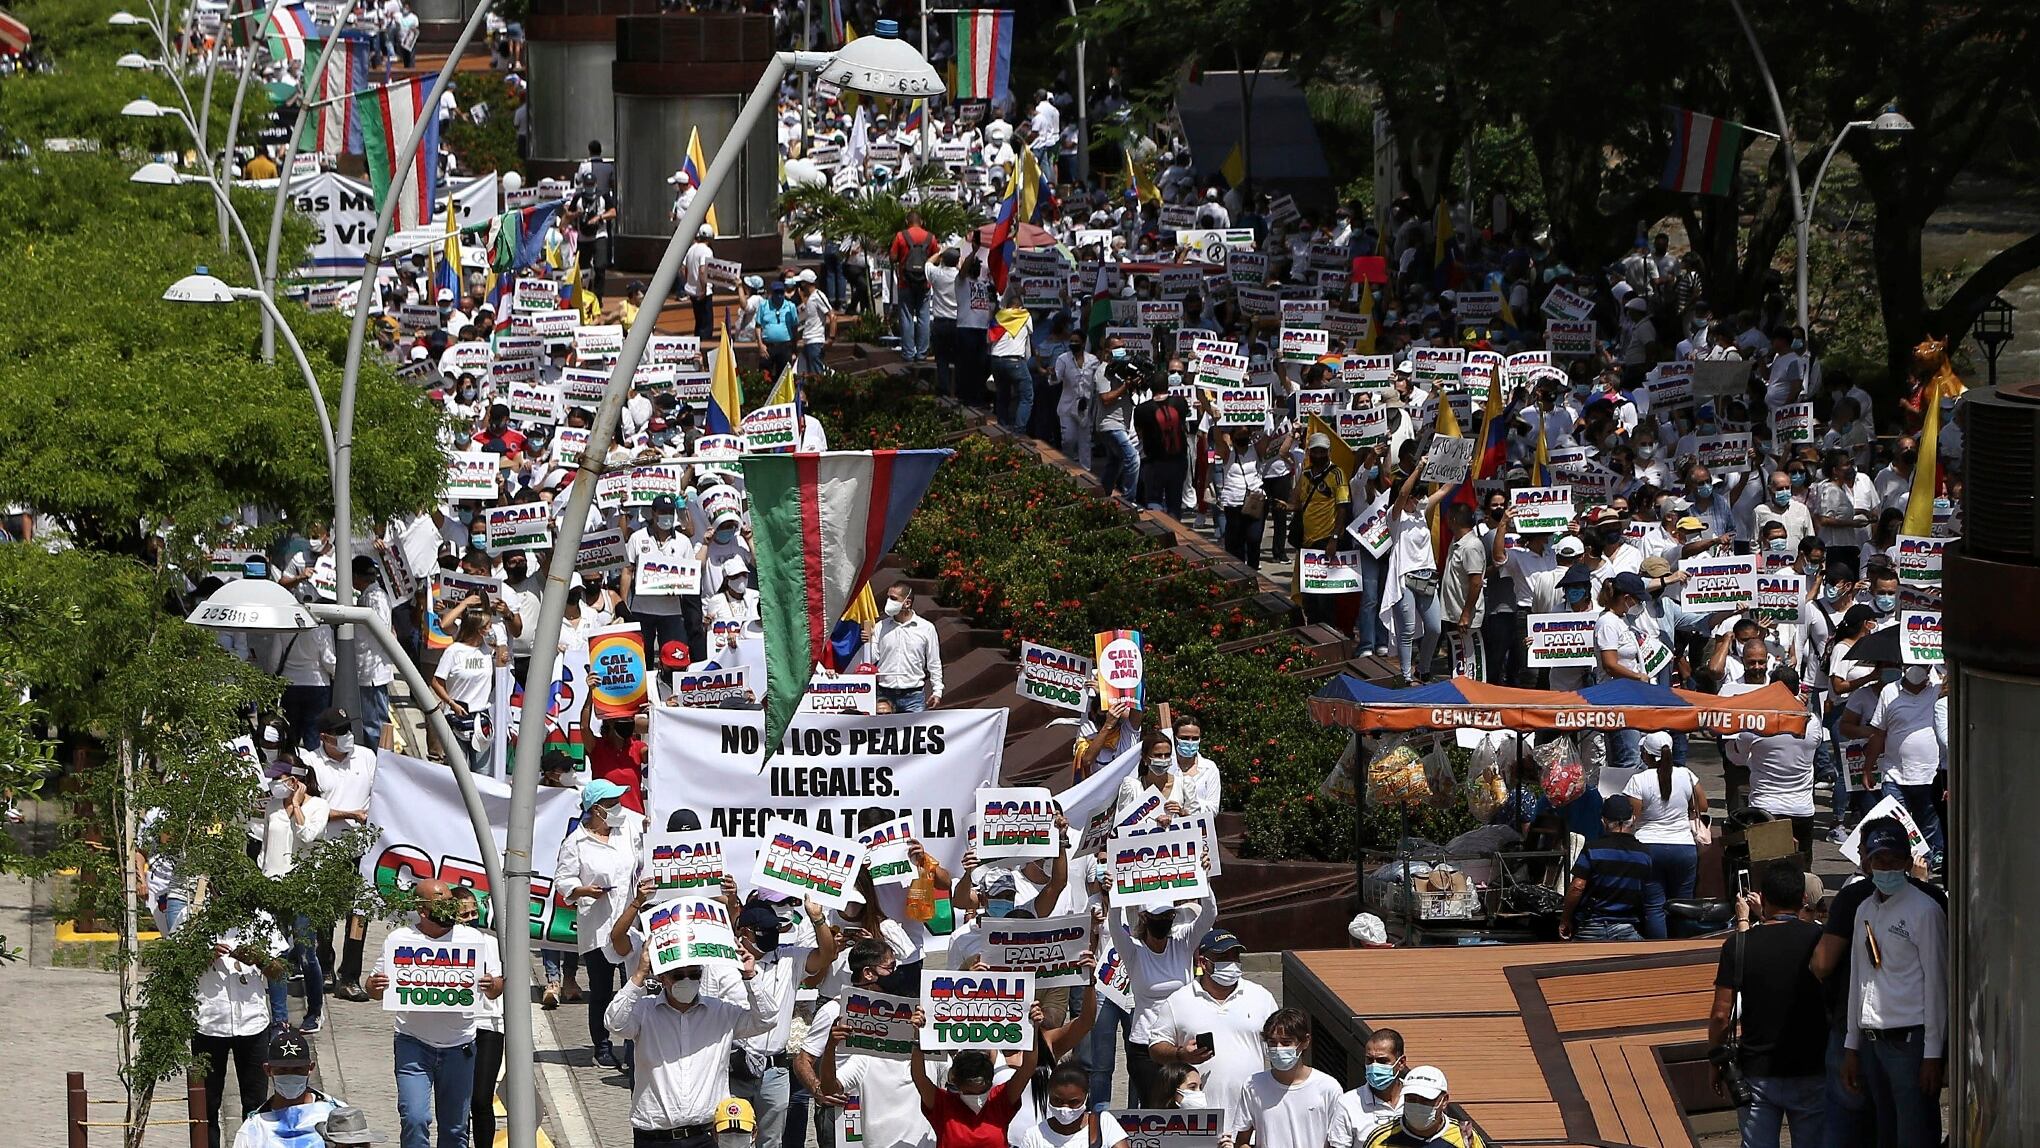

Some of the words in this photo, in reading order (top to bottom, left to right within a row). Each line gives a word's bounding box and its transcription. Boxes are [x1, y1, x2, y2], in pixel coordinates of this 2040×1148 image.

[1551, 322, 1593, 333] #CALI
[1283, 330, 1327, 344] #CALI
[1202, 353, 1245, 369] #CALI
[1343, 357, 1391, 371] #CALI
[1416, 350, 1461, 362] #CALI
[1222, 390, 1265, 402] #CALI
[1299, 390, 1344, 404] #CALI
[746, 407, 792, 423] #CALI
[1224, 402, 1266, 412] SOMOS
[1775, 405, 1809, 422] #CALI
[1224, 412, 1266, 423] TODOS
[1340, 408, 1385, 428] #CALI
[746, 421, 793, 435] SOMOS
[747, 432, 794, 446] TODOS
[1699, 439, 1748, 454] #CALI
[631, 466, 676, 481] #CALI
[631, 478, 677, 492] SOMOS
[1516, 489, 1568, 505] #CALI
[490, 506, 546, 527] #CALI
[1517, 507, 1540, 517] NOS
[1518, 516, 1569, 528] NECESITA
[492, 526, 517, 537] NOS
[1304, 552, 1358, 568] #CALI
[1900, 557, 1927, 568] NOS
[644, 562, 696, 578] #CALI
[1304, 568, 1328, 579] NOS
[1687, 563, 1752, 575] #LIBERTAD
[1304, 578, 1359, 589] NECESITA
[1697, 577, 1738, 591] PARA
[1685, 590, 1753, 605] TRABAJAR
[1533, 620, 1597, 632] #LIBERTAD
[1544, 633, 1585, 647] PARA
[607, 664, 628, 675] ME
[1026, 646, 1087, 676] #CALI
[1115, 659, 1135, 669] ME
[601, 674, 635, 686] AMA
[681, 671, 743, 692] #CALI
[1026, 664, 1084, 692] SOMOS
[1109, 670, 1139, 680] AMA
[1025, 678, 1081, 706] TODOS
[812, 695, 857, 710] PARA
[1431, 708, 1502, 727] CERVEZA
[1554, 711, 1626, 729] GASEOSA
[1697, 711, 1732, 729] VIVE
[1737, 713, 1766, 731] 100
[721, 724, 760, 755] NO
[792, 725, 842, 757] LOS
[850, 724, 946, 756] PEAJES
[770, 765, 900, 797] ILEGALES.
[984, 800, 1052, 824] #CALI
[923, 808, 956, 838] LA
[983, 823, 1050, 847] LIBRE
[653, 841, 721, 866] #CALI
[770, 832, 855, 877] #CALI
[1115, 841, 1196, 873] #CALI
[653, 864, 723, 890] LIBRE
[763, 856, 847, 898] LIBRE
[1116, 865, 1199, 895] LIBRE
[650, 902, 727, 935] #CALI
[654, 926, 697, 950] NOS
[989, 926, 1085, 946] #LIBERTAD
[393, 945, 476, 970] #CALI
[658, 943, 738, 965] NECESITA
[1004, 944, 1065, 965] PARA
[396, 969, 475, 988] SOMOS
[396, 987, 475, 1007] TODOS
[931, 976, 1025, 1003] #CALI
[846, 994, 914, 1026] #CA
[933, 1003, 1023, 1023] SOMOS
[850, 1019, 889, 1038] NOS
[933, 1022, 1023, 1044] TODOS
[1118, 1113, 1218, 1138] #CALI
